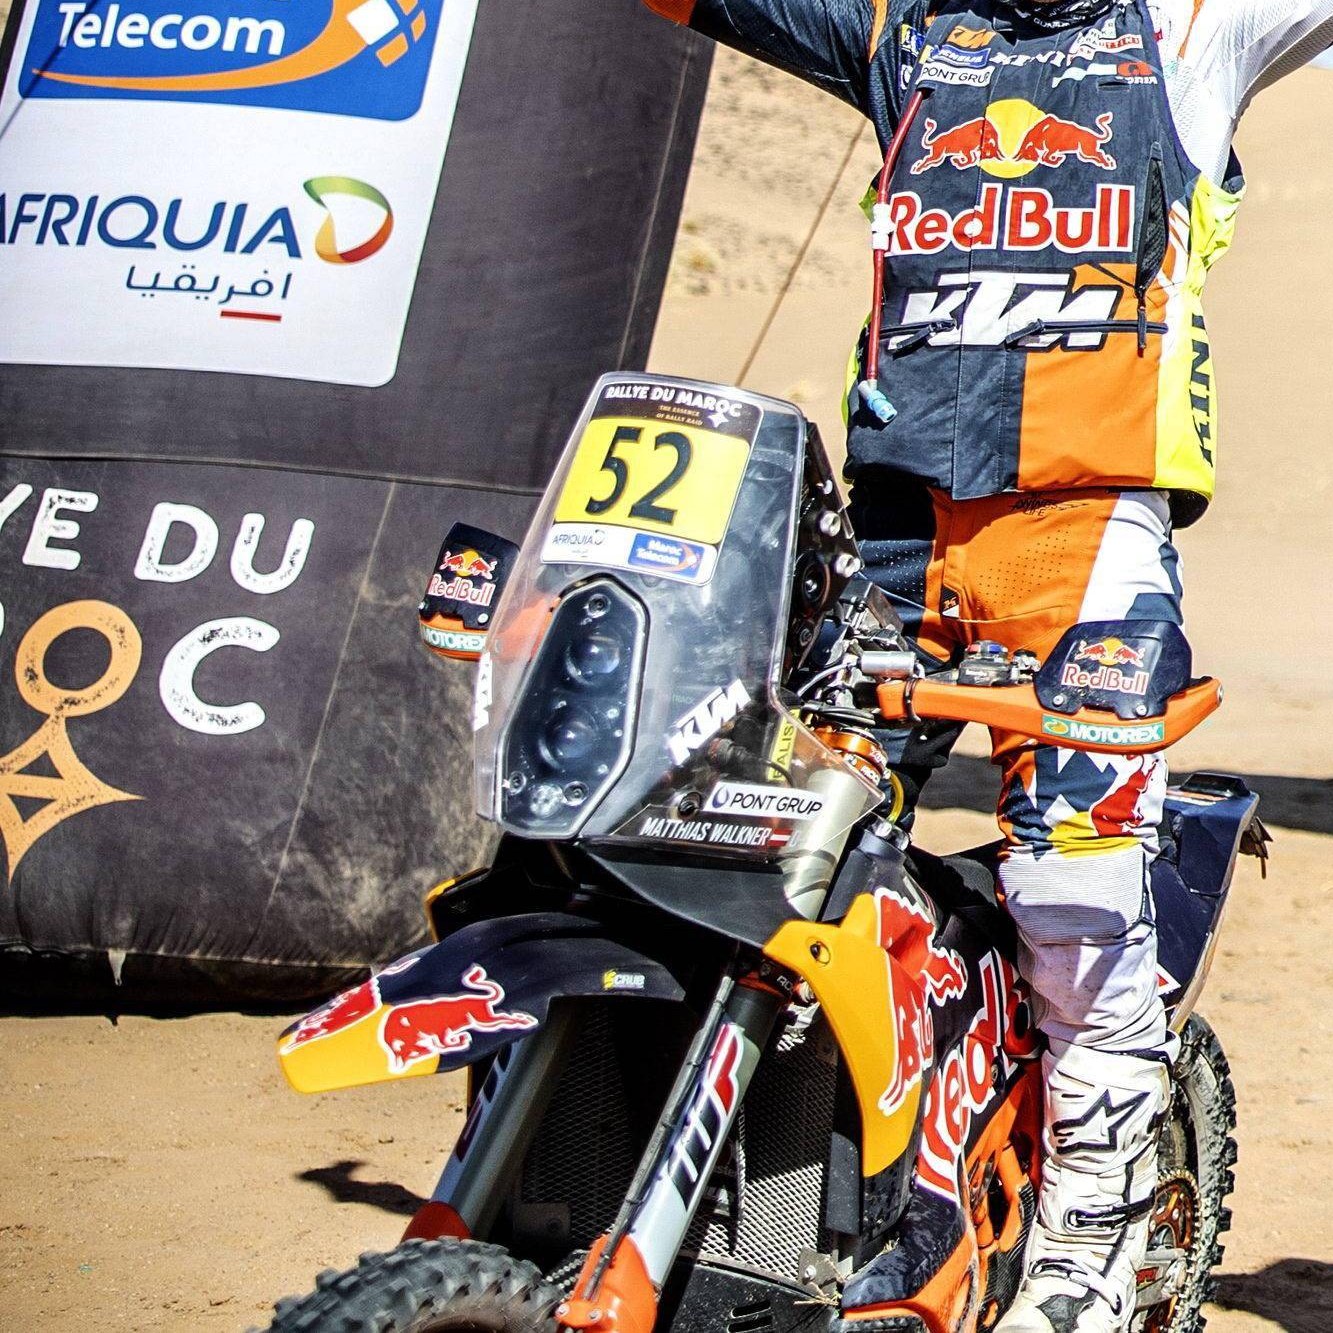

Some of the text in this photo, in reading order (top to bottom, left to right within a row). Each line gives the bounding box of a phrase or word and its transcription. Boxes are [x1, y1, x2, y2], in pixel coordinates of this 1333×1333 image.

[58, 2, 287, 57] Telecom
[0, 192, 303, 259] FRIQUIA
[889, 185, 1133, 252] Red Bull
[887, 269, 1118, 351] KTM
[605, 385, 650, 399] RALLYE
[650, 387, 676, 402] DU
[584, 425, 693, 525] 52
[134, 501, 316, 594] DU
[427, 574, 496, 607] Red Bull
[0, 599, 281, 736] OC
[1061, 664, 1150, 696] Red Bull
[666, 678, 752, 767] KTM
[1069, 722, 1164, 744] MOTOREX
[639, 817, 712, 841] MATTHIAS
[709, 823, 773, 846] WALKNER
[730, 792, 823, 816] PONT GRUP
